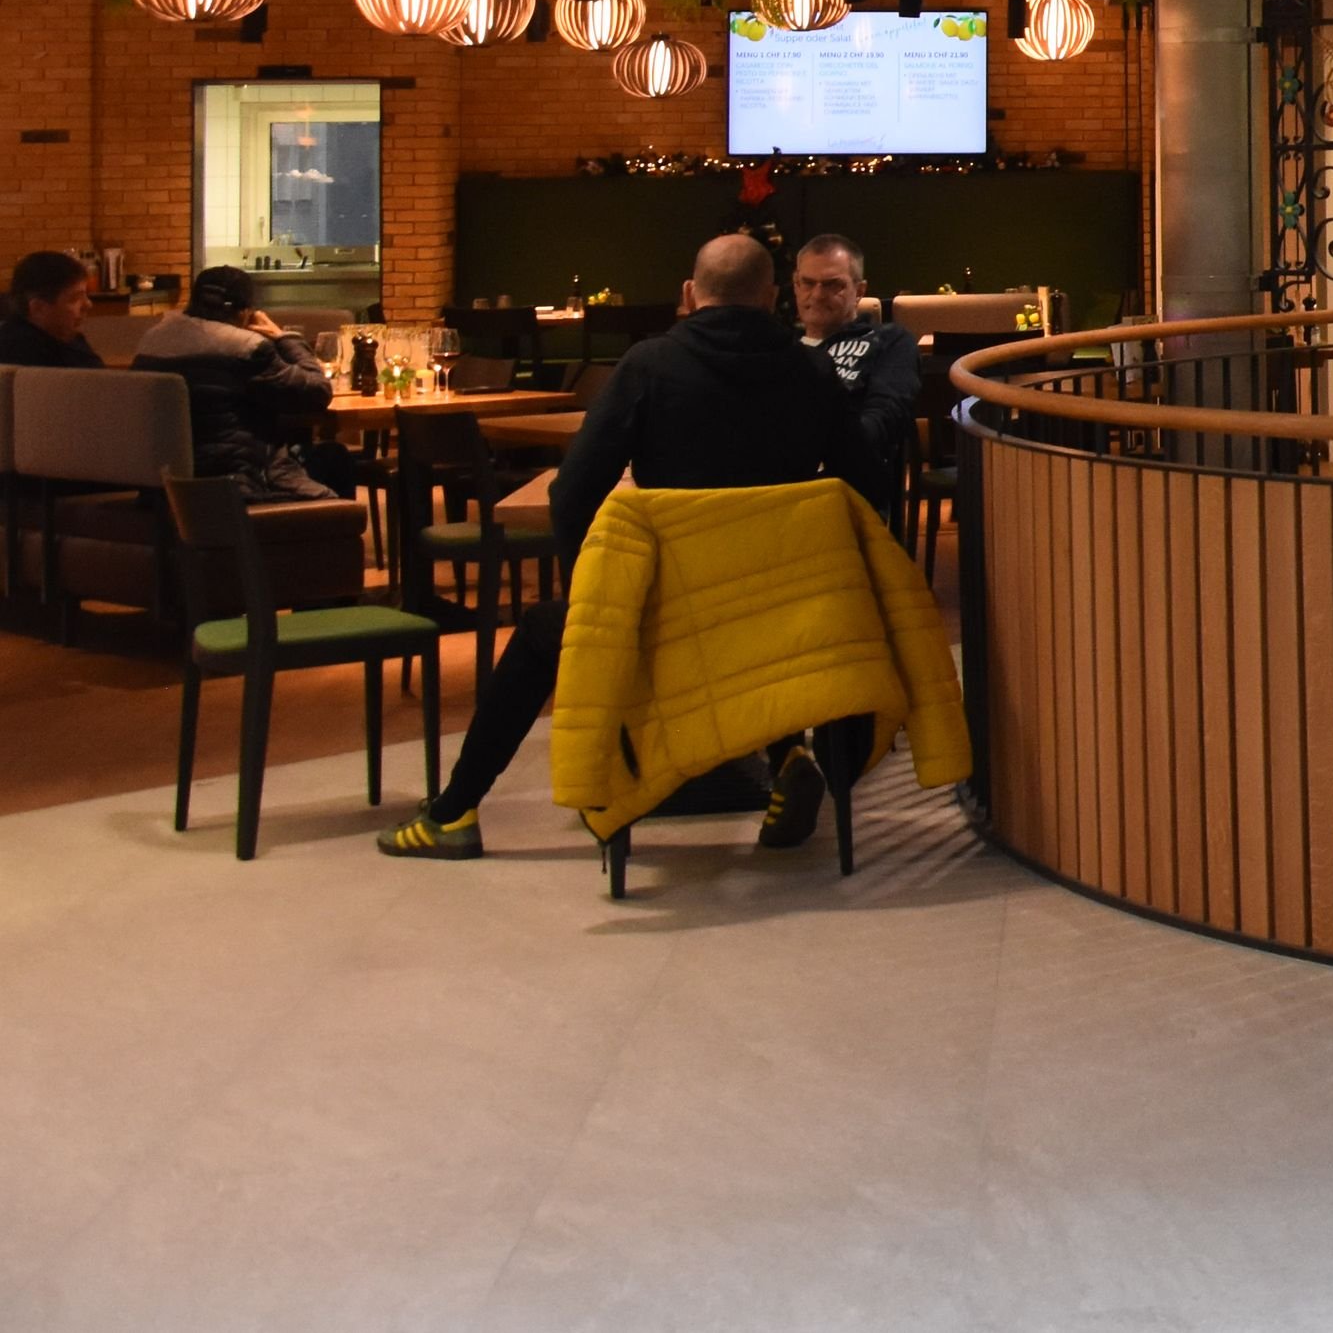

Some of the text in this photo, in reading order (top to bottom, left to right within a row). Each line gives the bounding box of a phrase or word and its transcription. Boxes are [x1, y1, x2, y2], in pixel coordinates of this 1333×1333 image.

[774, 32, 803, 44] Suppe
[805, 31, 827, 42] oder
[829, 31, 851, 42] Salat
[766, 51, 780, 59] CHF
[850, 51, 863, 59] CHF
[934, 51, 947, 59] CHF
[833, 355, 859, 368] AN
